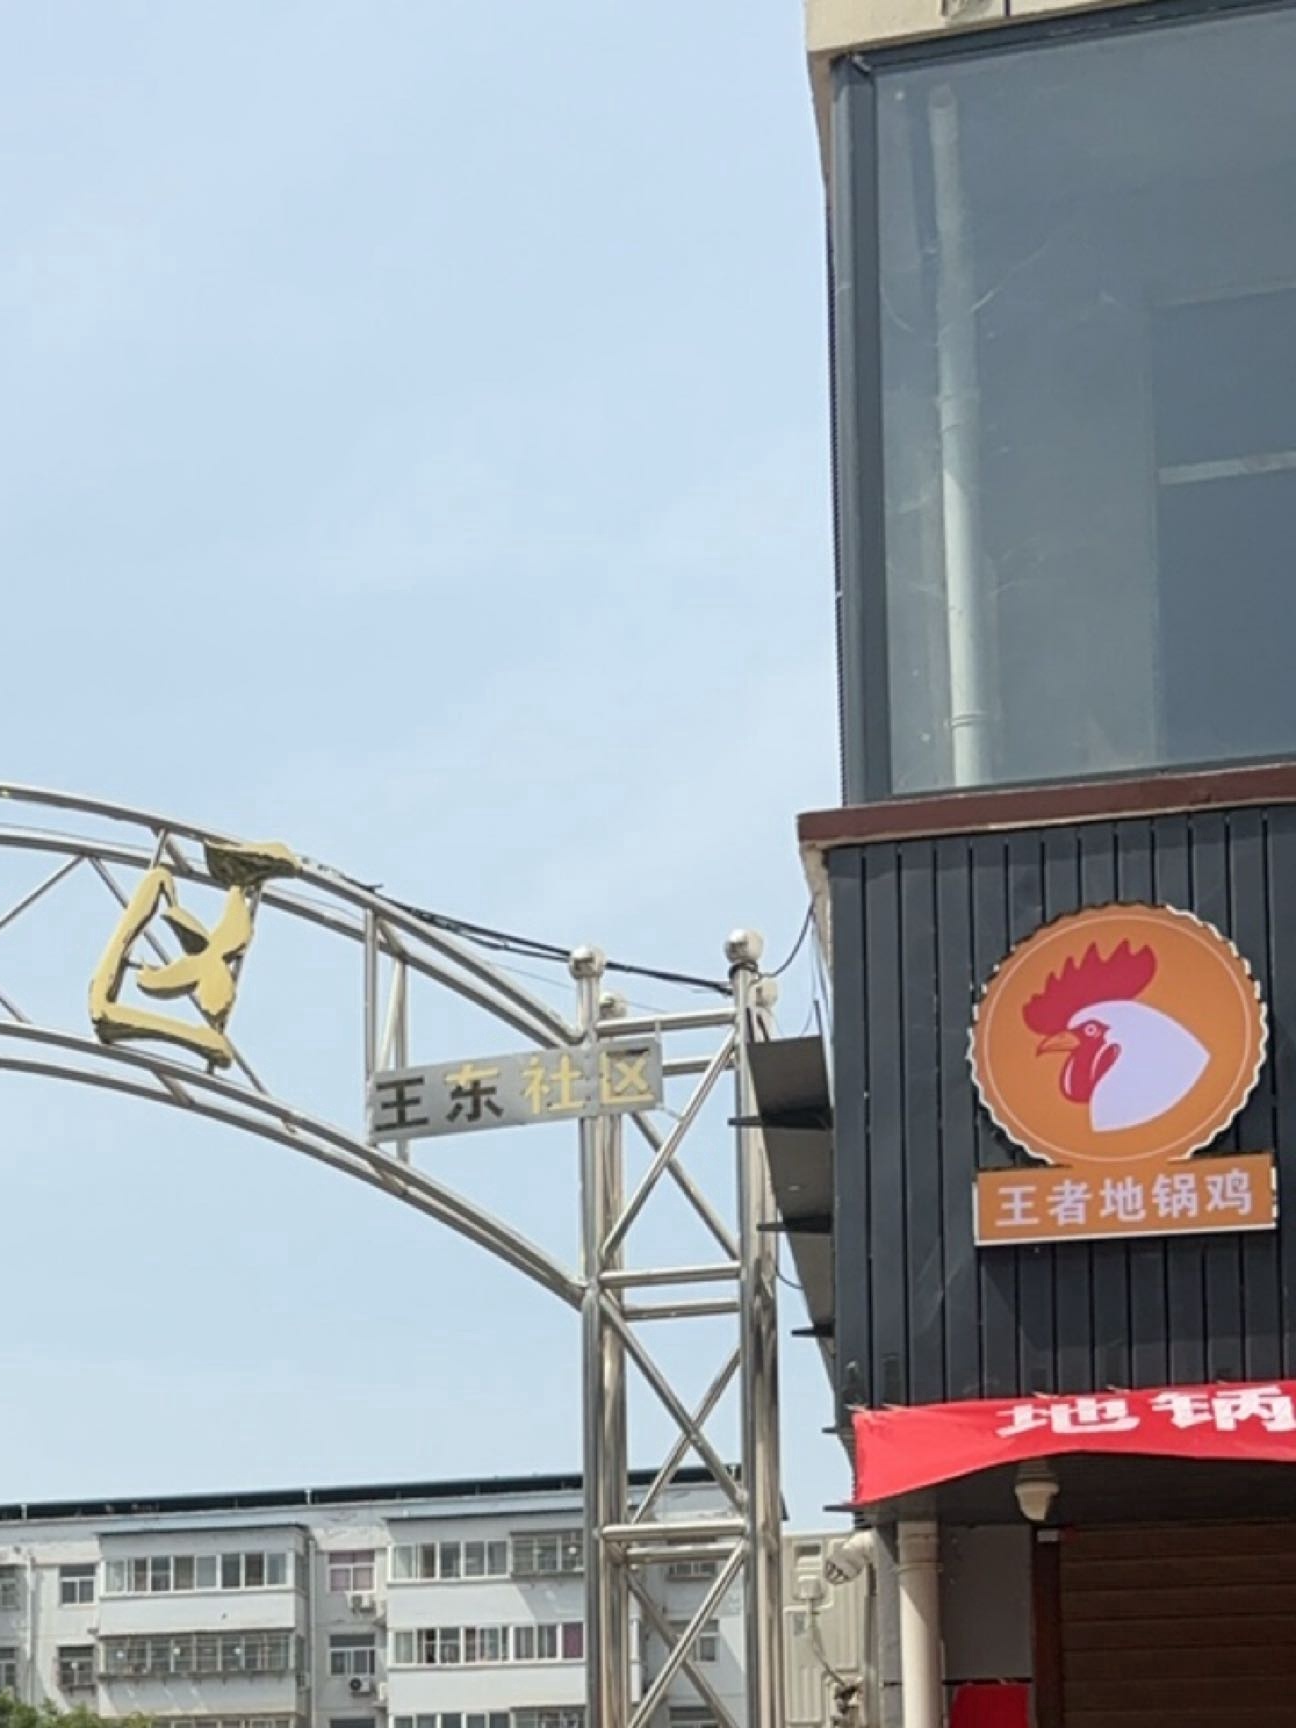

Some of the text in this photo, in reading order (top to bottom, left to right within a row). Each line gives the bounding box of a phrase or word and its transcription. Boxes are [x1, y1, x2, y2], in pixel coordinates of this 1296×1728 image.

[375, 1050, 654, 1131] 王东社区
[997, 1169, 1252, 1226] 王者地锅鸡
